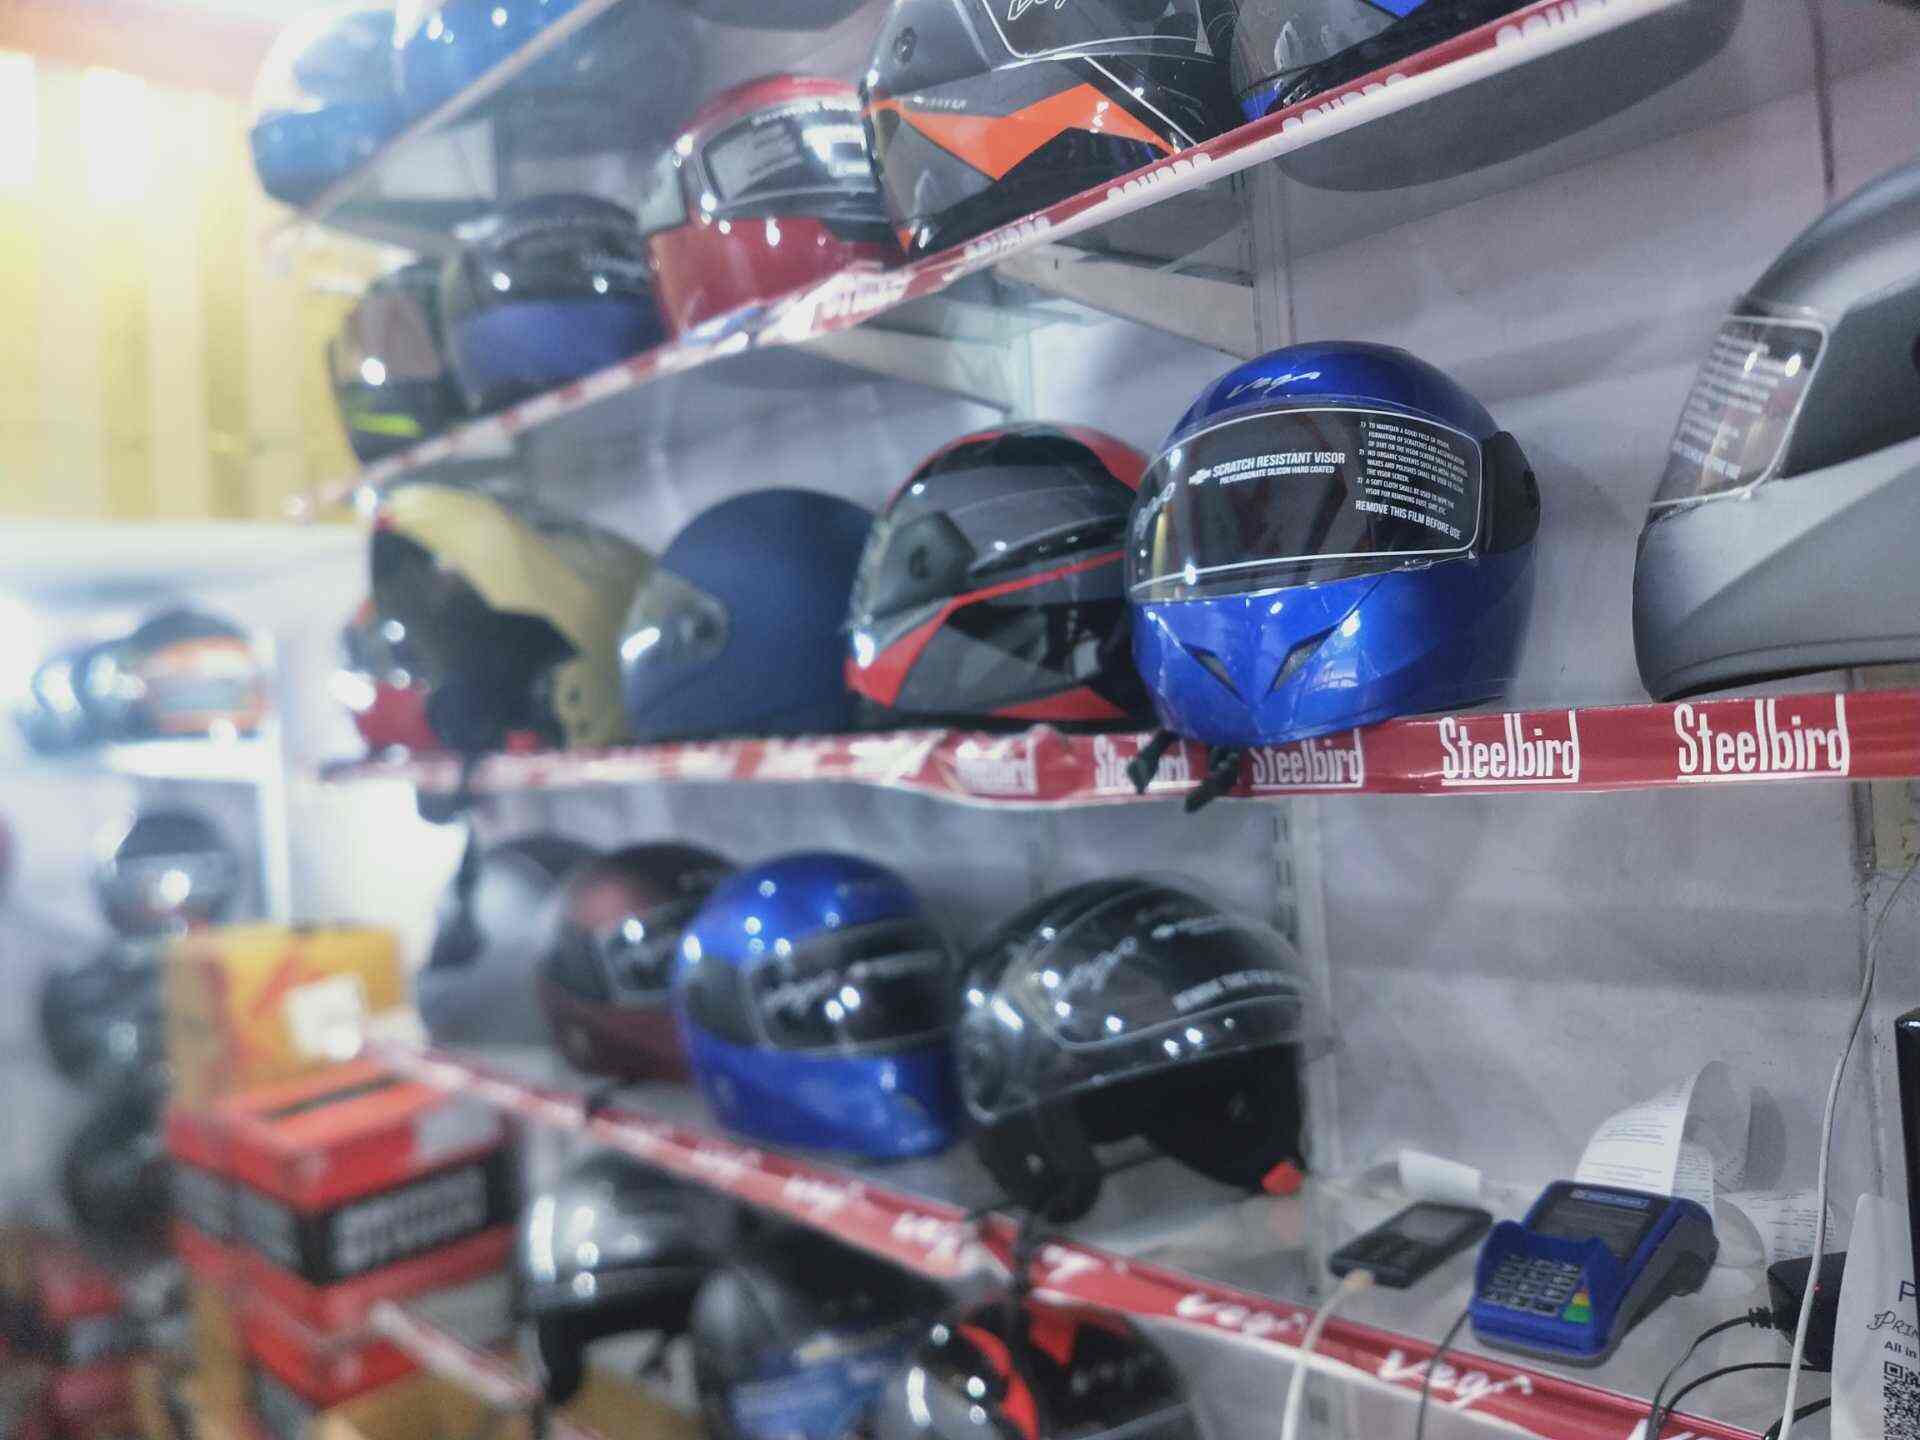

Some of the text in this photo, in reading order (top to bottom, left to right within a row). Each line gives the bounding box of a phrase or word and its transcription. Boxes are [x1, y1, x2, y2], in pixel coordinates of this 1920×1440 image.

[1212, 451, 1346, 478] SCRATCH RESISTANT VISOR
[1310, 466, 1335, 474] COATED
[1356, 500, 1462, 540] REMOVE THIS FILM BEFORE USE
[1250, 727, 1364, 788] Steelbird
[1439, 709, 1580, 785] Steelbird
[1673, 694, 1849, 781] Steelbird
